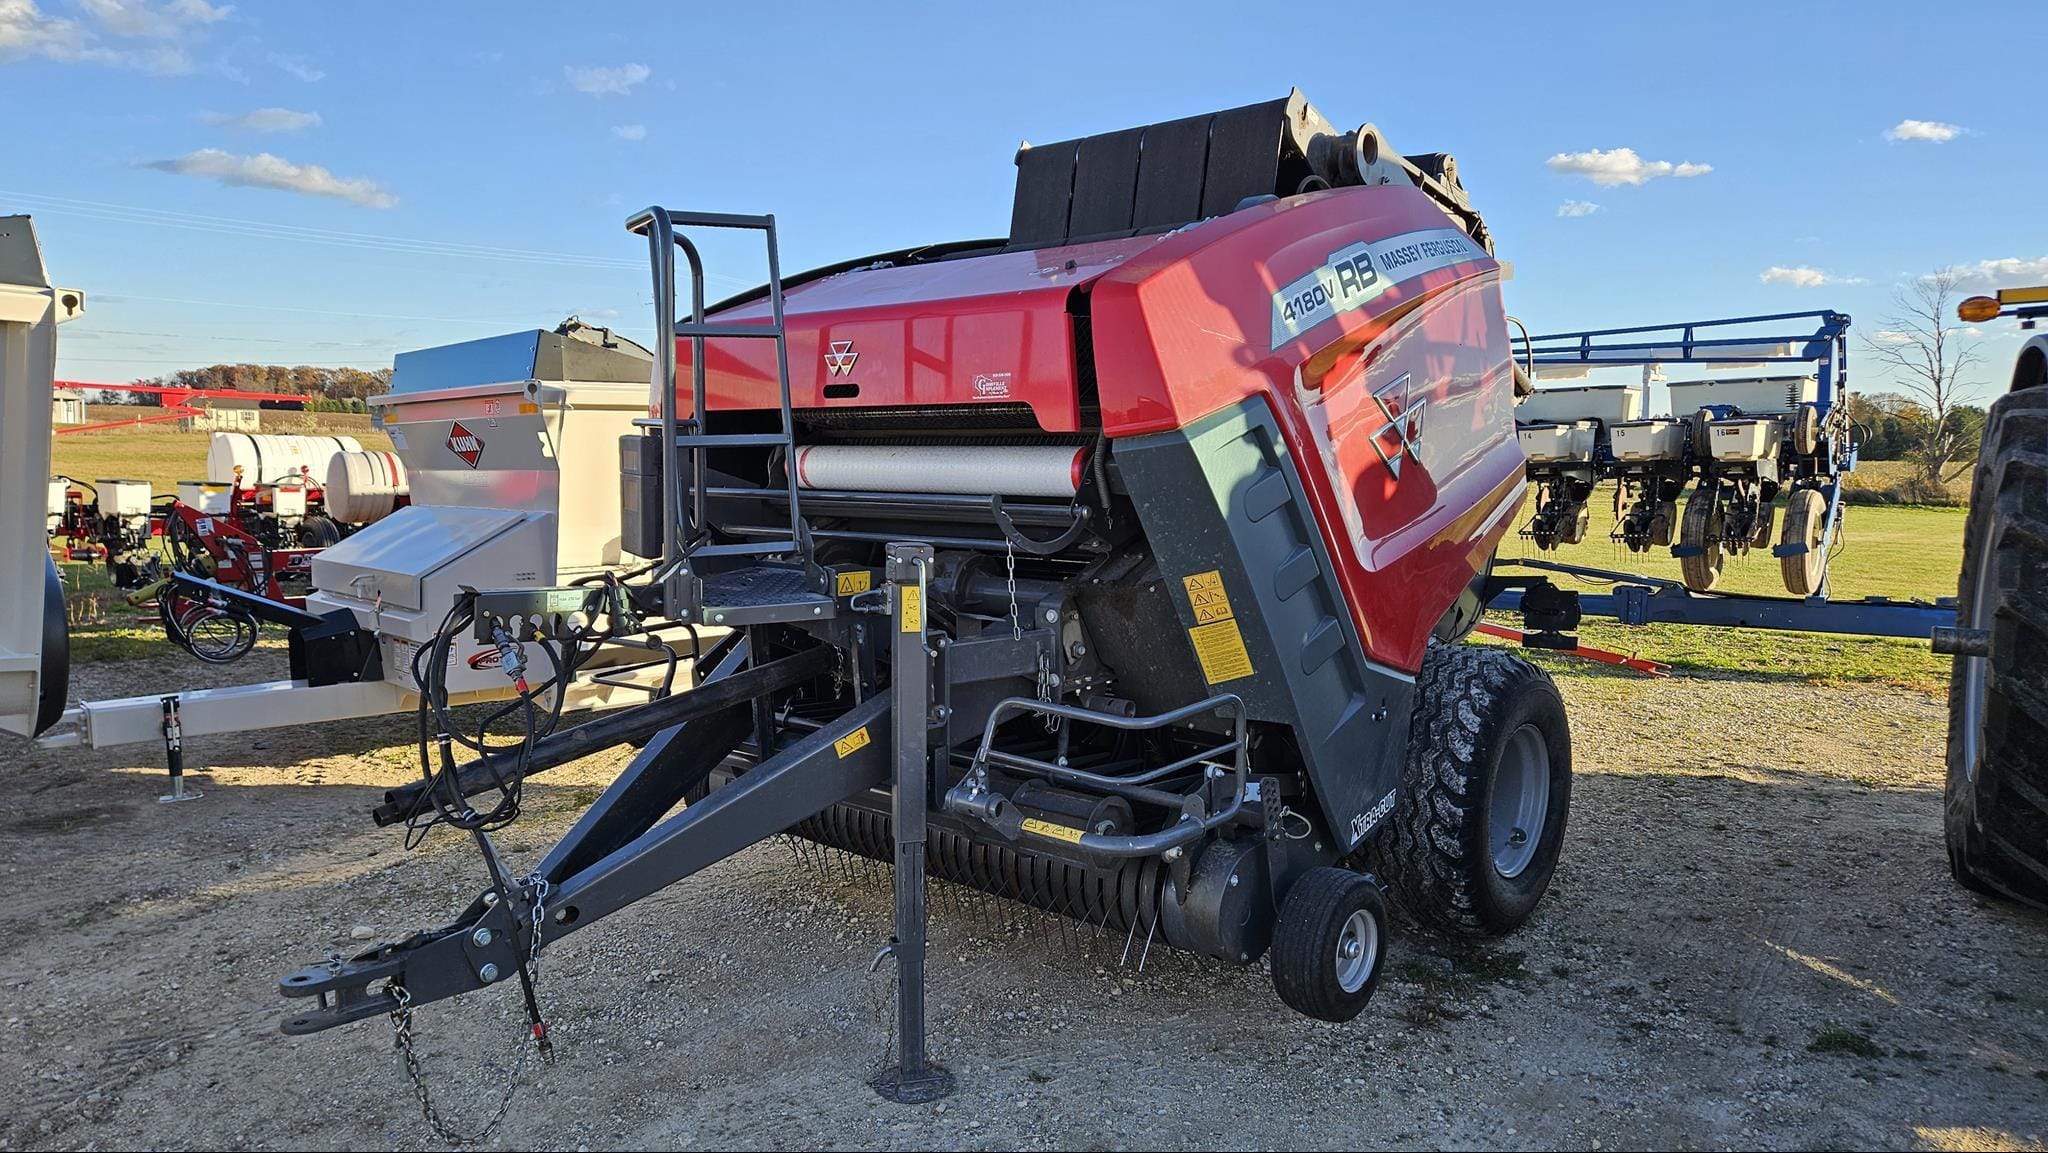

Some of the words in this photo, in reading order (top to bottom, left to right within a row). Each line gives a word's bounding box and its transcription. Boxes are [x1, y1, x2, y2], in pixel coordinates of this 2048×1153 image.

[1282, 278, 1334, 321] 4180V
[1334, 252, 1378, 298] RB
[1379, 244, 1422, 271] MASSEY
[1420, 239, 1468, 258] FERGUSON
[1523, 432, 1532, 440] 14
[1616, 429, 1626, 437] 15
[1716, 428, 1726, 437] 16
[450, 435, 480, 452] KUHN
